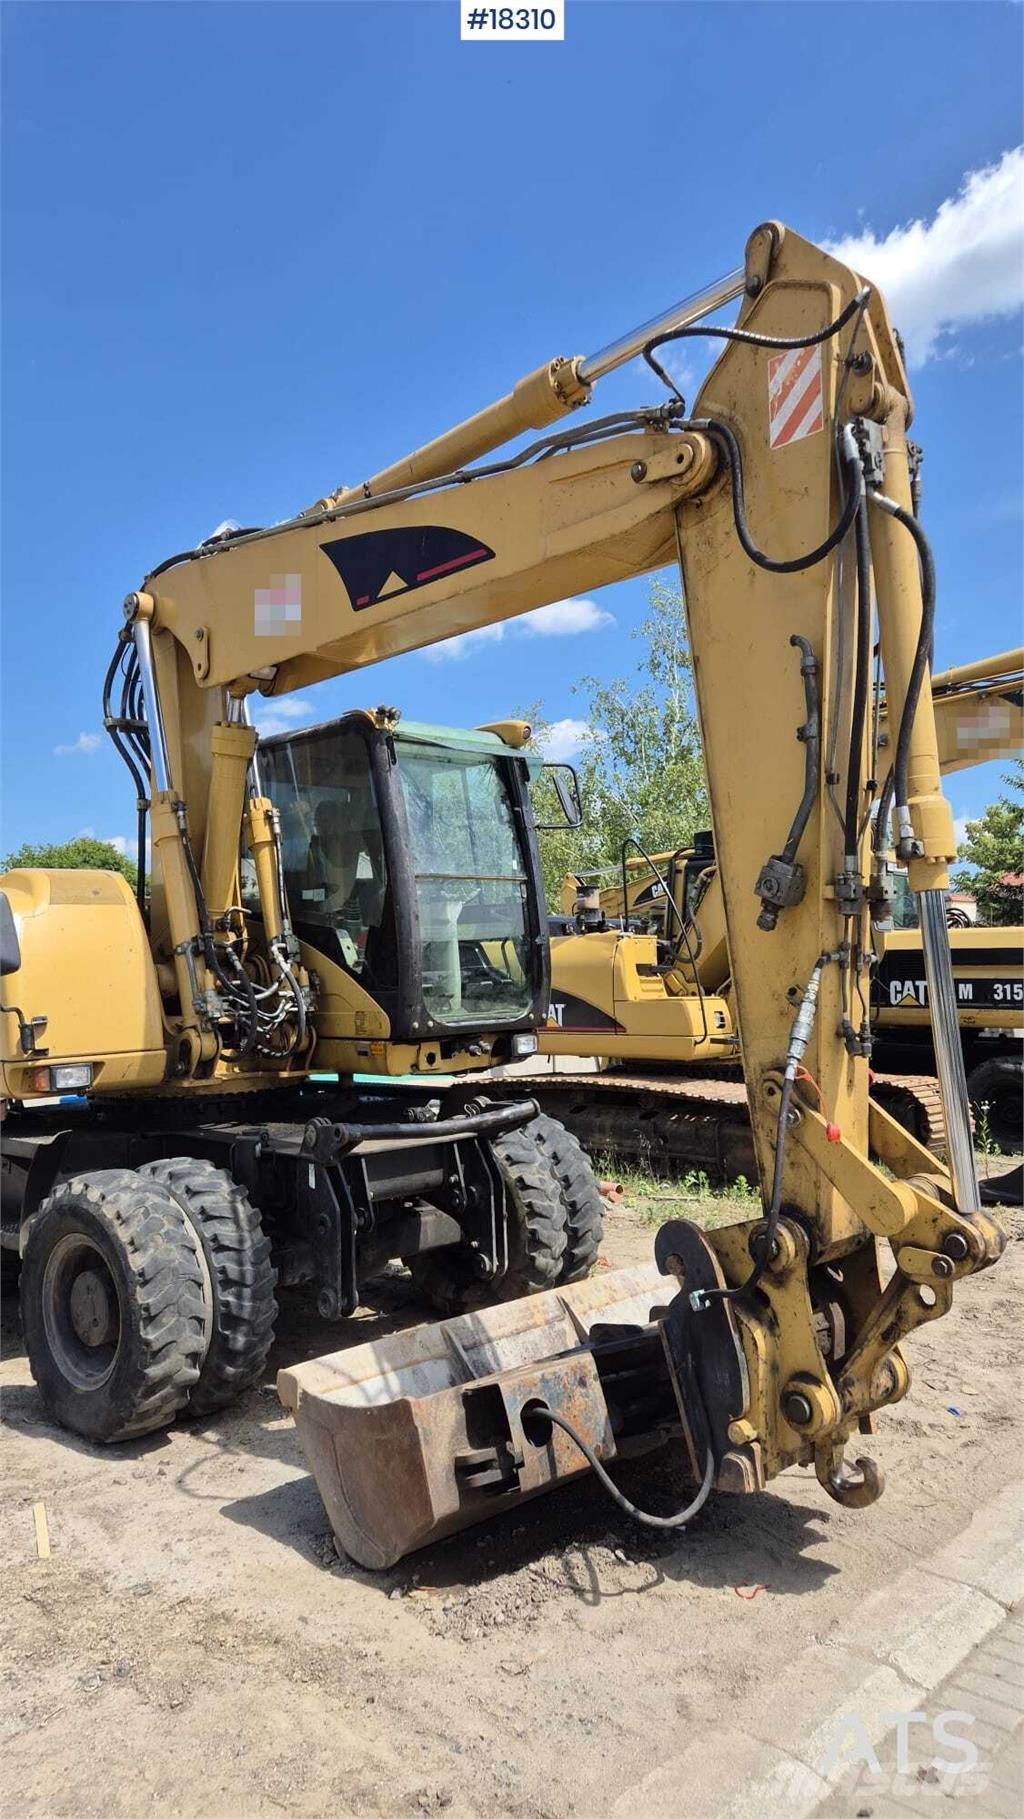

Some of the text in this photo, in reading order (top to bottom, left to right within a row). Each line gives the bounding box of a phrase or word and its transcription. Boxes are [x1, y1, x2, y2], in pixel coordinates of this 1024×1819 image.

[889, 980, 1023, 1006] CAT M 315
[547, 1004, 566, 1028] AT
